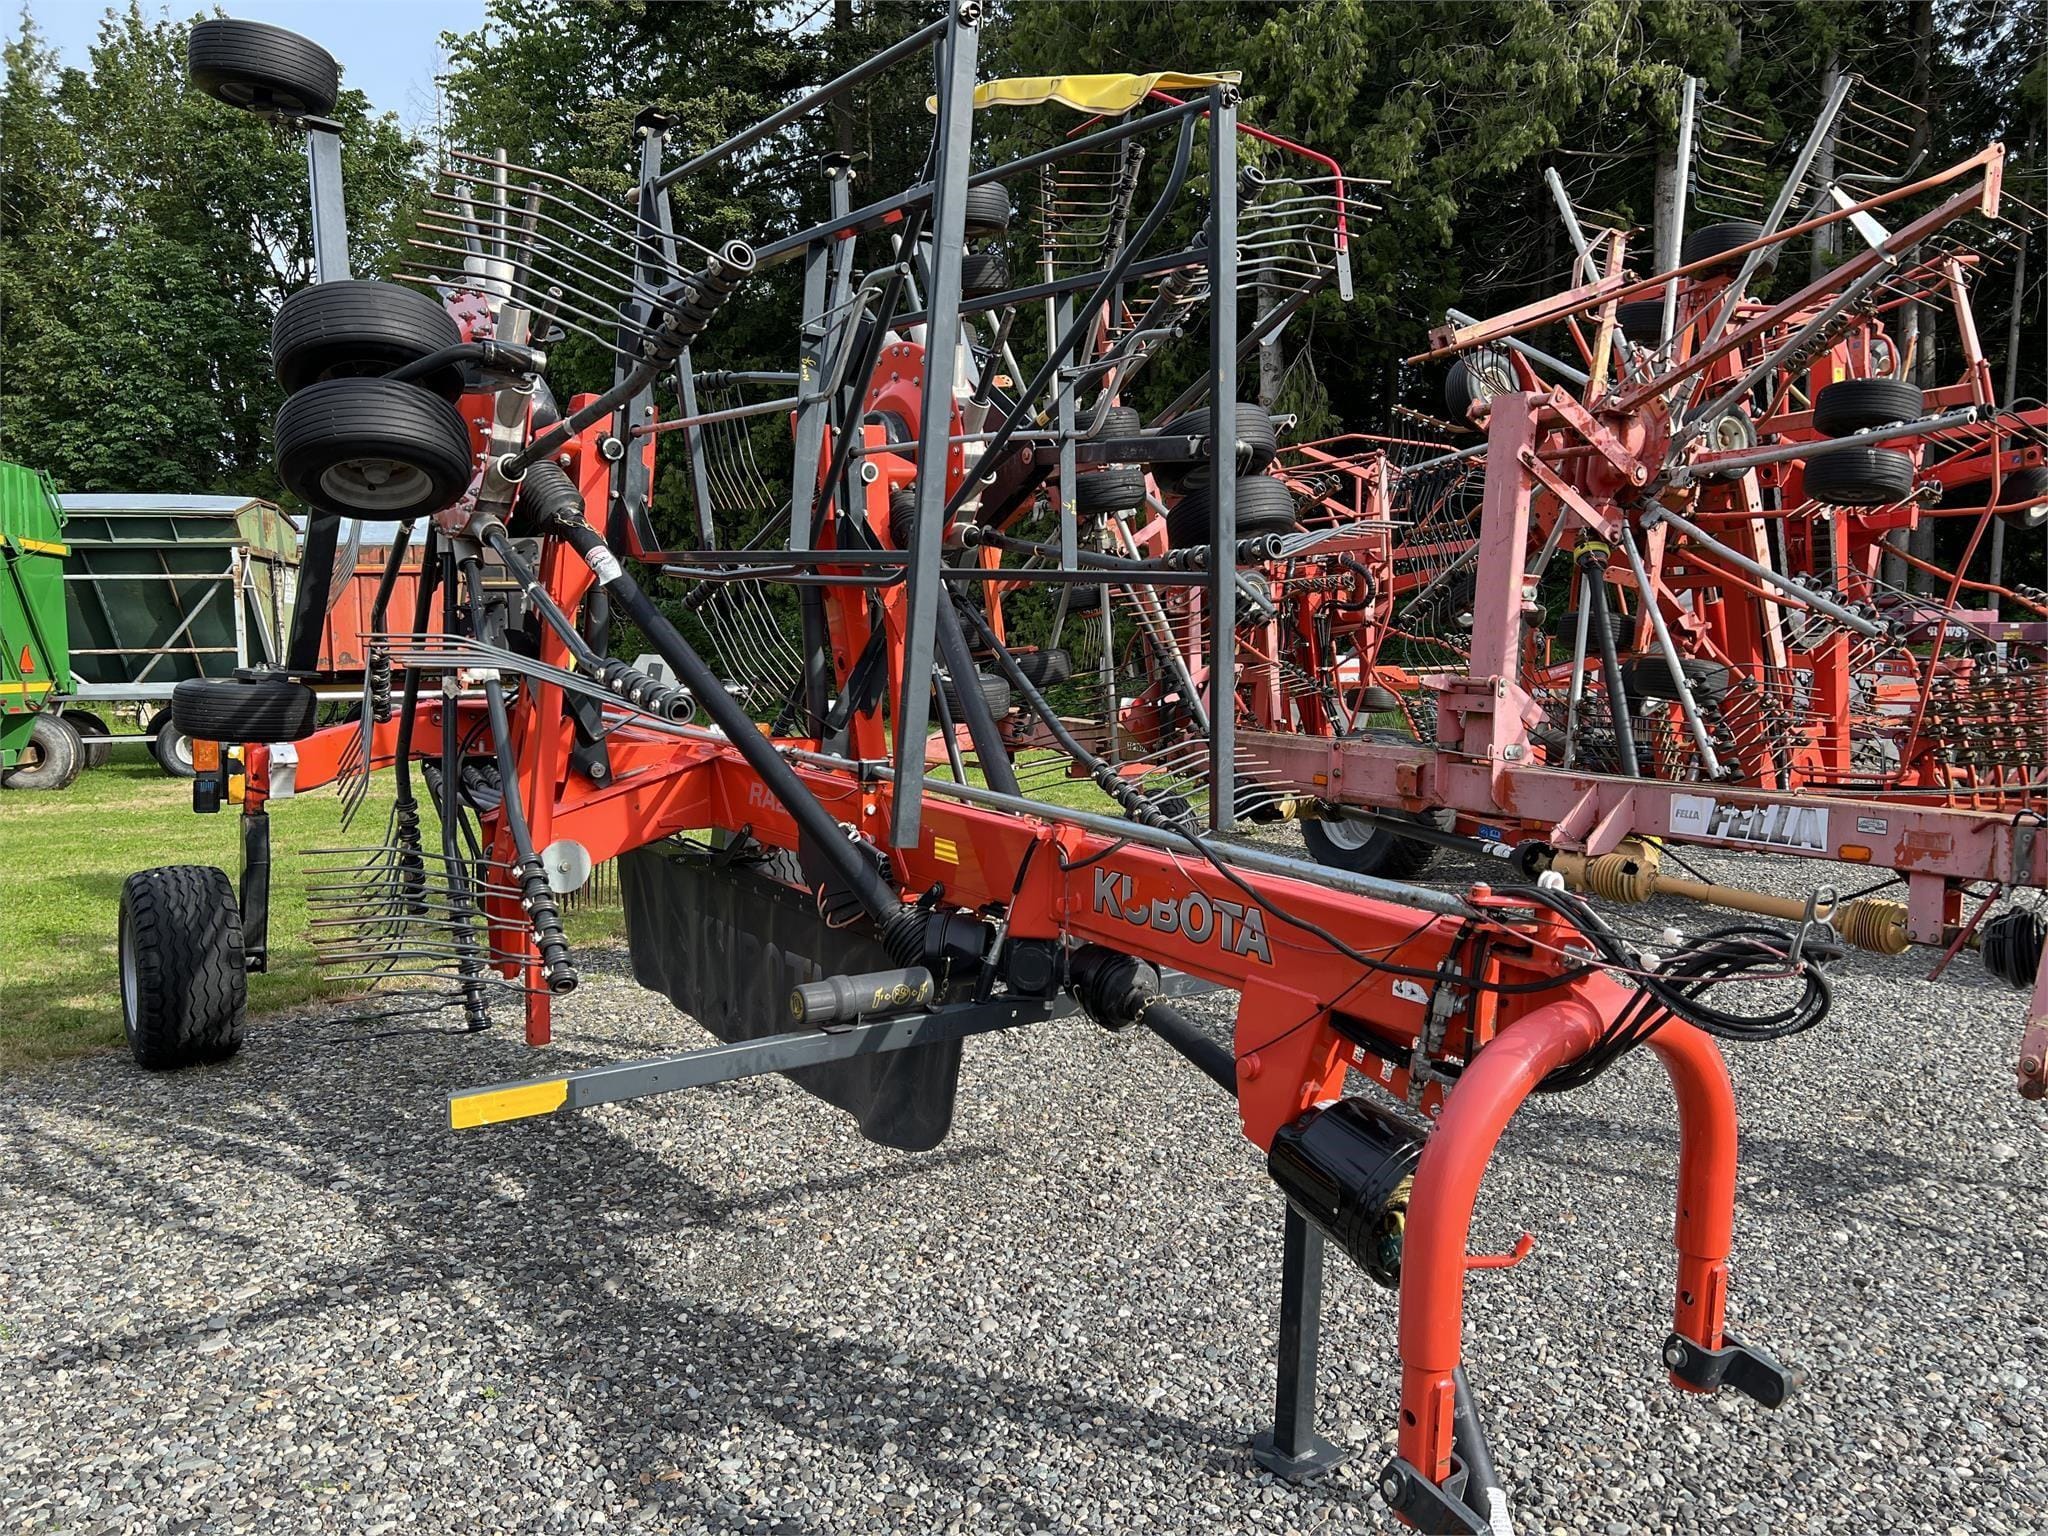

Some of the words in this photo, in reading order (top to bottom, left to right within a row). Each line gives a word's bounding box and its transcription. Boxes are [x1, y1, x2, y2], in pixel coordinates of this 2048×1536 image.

[1675, 808, 1700, 820] FELLA
[1706, 801, 1823, 849] FELLA
[1093, 867, 1272, 965] KUBOTA
